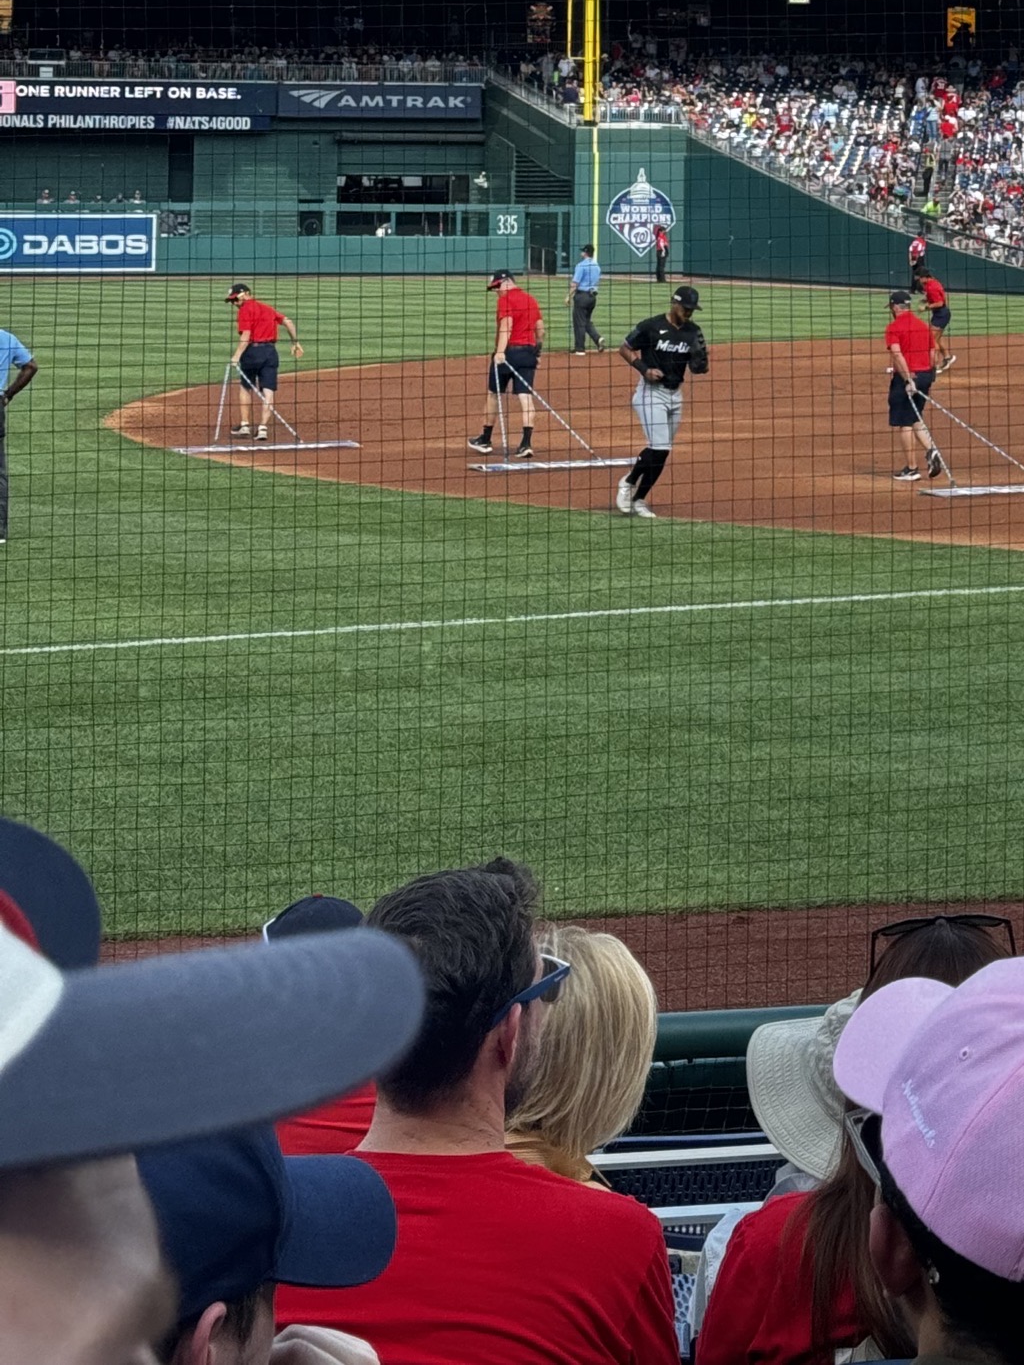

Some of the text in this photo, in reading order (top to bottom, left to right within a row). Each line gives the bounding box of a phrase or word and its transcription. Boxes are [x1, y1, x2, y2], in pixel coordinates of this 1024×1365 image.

[16, 85, 242, 100] ONE RUNNER LEFT ON BASE.
[48, 115, 155, 129] PHILANTHROPIES
[166, 116, 251, 130] #NATS4GOOD
[620, 204, 663, 214] WORLD
[496, 214, 518, 235] 335
[609, 213, 672, 224] CHAMPIONS
[22, 234, 149, 256] DABOS
